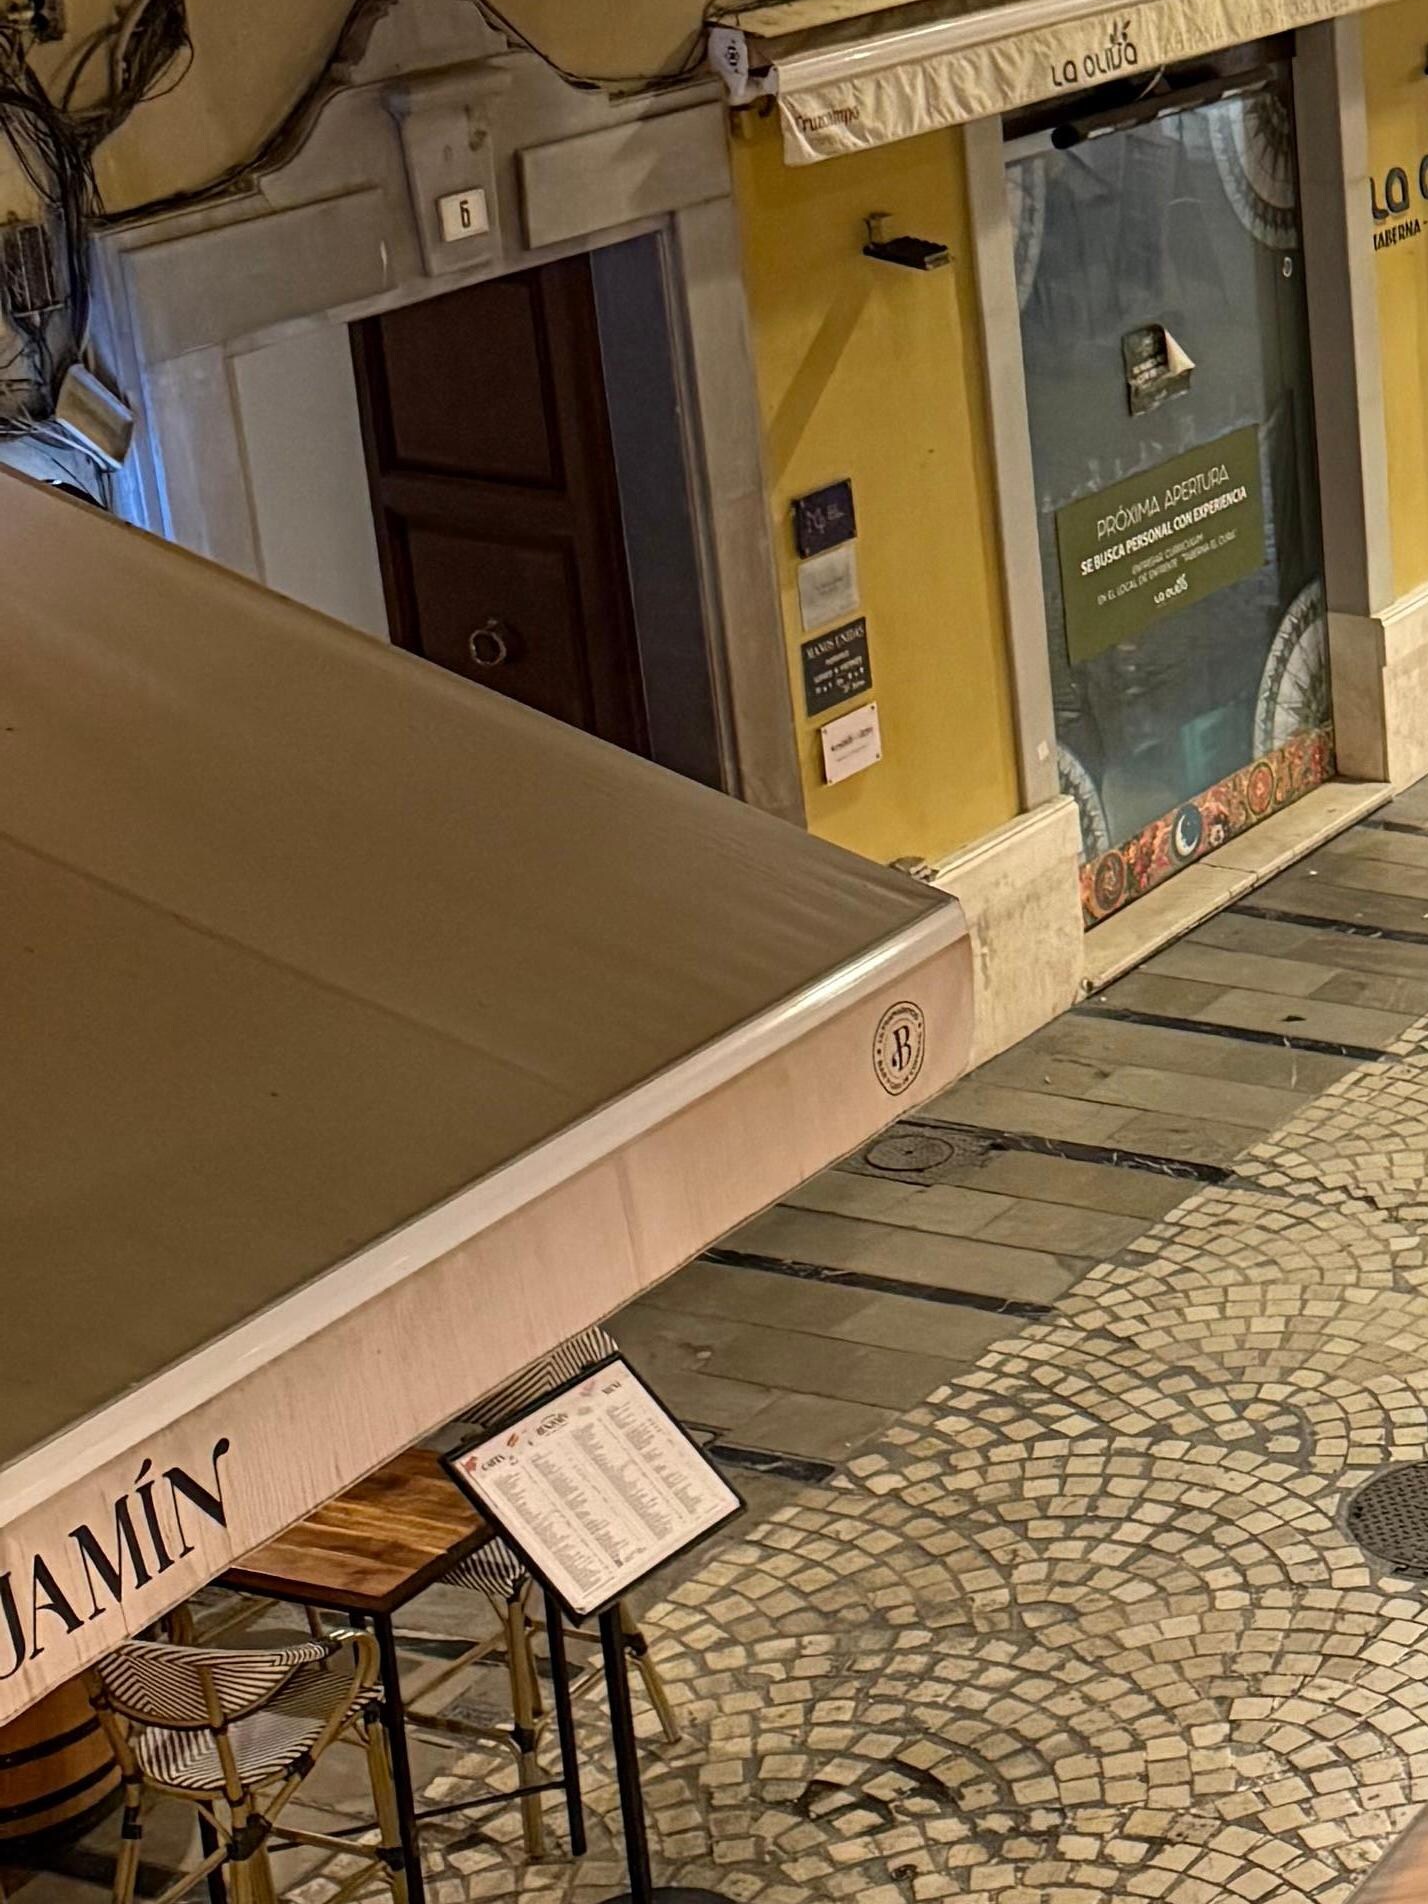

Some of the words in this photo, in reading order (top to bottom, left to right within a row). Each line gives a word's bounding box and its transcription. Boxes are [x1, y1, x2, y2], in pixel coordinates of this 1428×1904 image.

[459, 199, 472, 229] 6
[1080, 559, 1094, 576] SE
[1093, 544, 1126, 570] BUSCA
[1126, 521, 1173, 554] PERSONAL
[1173, 511, 1193, 530] CON
[1193, 486, 1248, 523] EXPERIENCIA
[1097, 496, 1160, 541] PRÓXIMA
[1164, 464, 1229, 510] APERTURA
